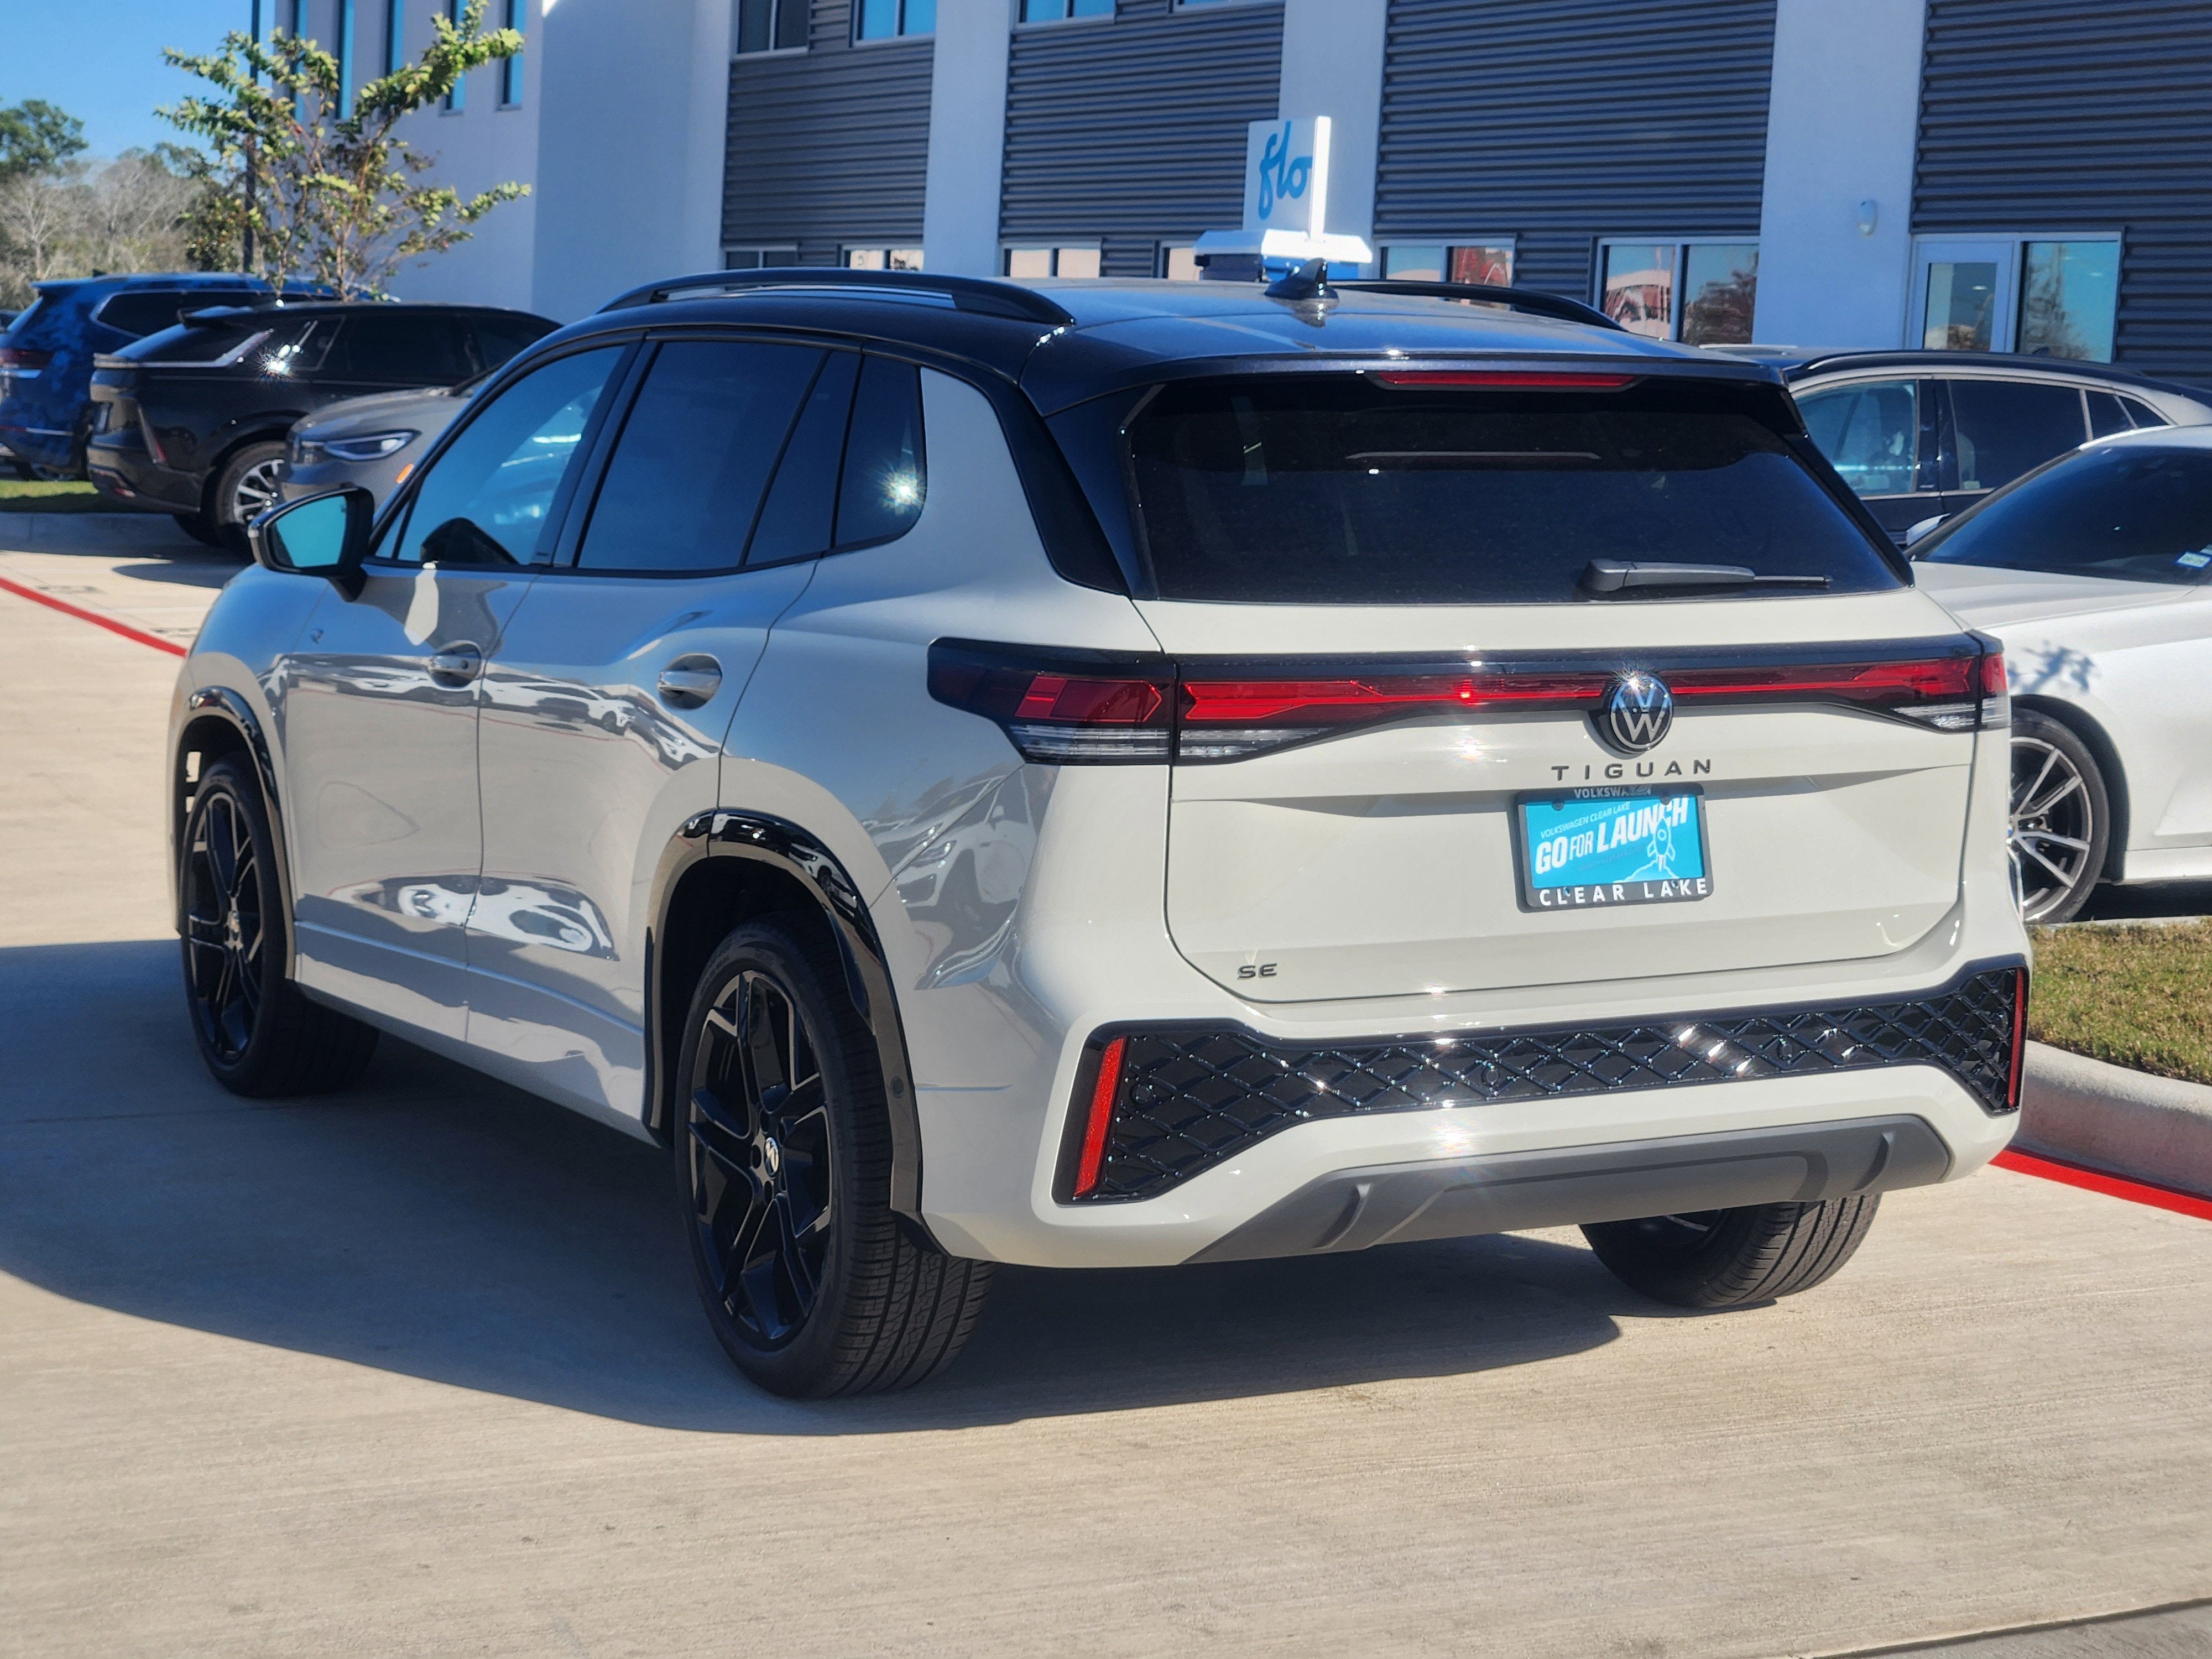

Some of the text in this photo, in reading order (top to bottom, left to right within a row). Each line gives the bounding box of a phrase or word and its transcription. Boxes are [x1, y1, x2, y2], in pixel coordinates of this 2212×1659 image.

[1258, 121, 1313, 219] flo
[1551, 759, 1711, 781] TIGUAN
[1574, 784, 1652, 799] VOLKSWA
[1540, 801, 1631, 839] VOLKSWAGEN CLEAR LAKE
[1535, 836, 1568, 875] GO
[1569, 830, 1594, 860] FOR
[1597, 795, 1688, 853] LAUNCH
[1540, 878, 1708, 906] CLEAR LAKE
[1238, 963, 1277, 979] SE
